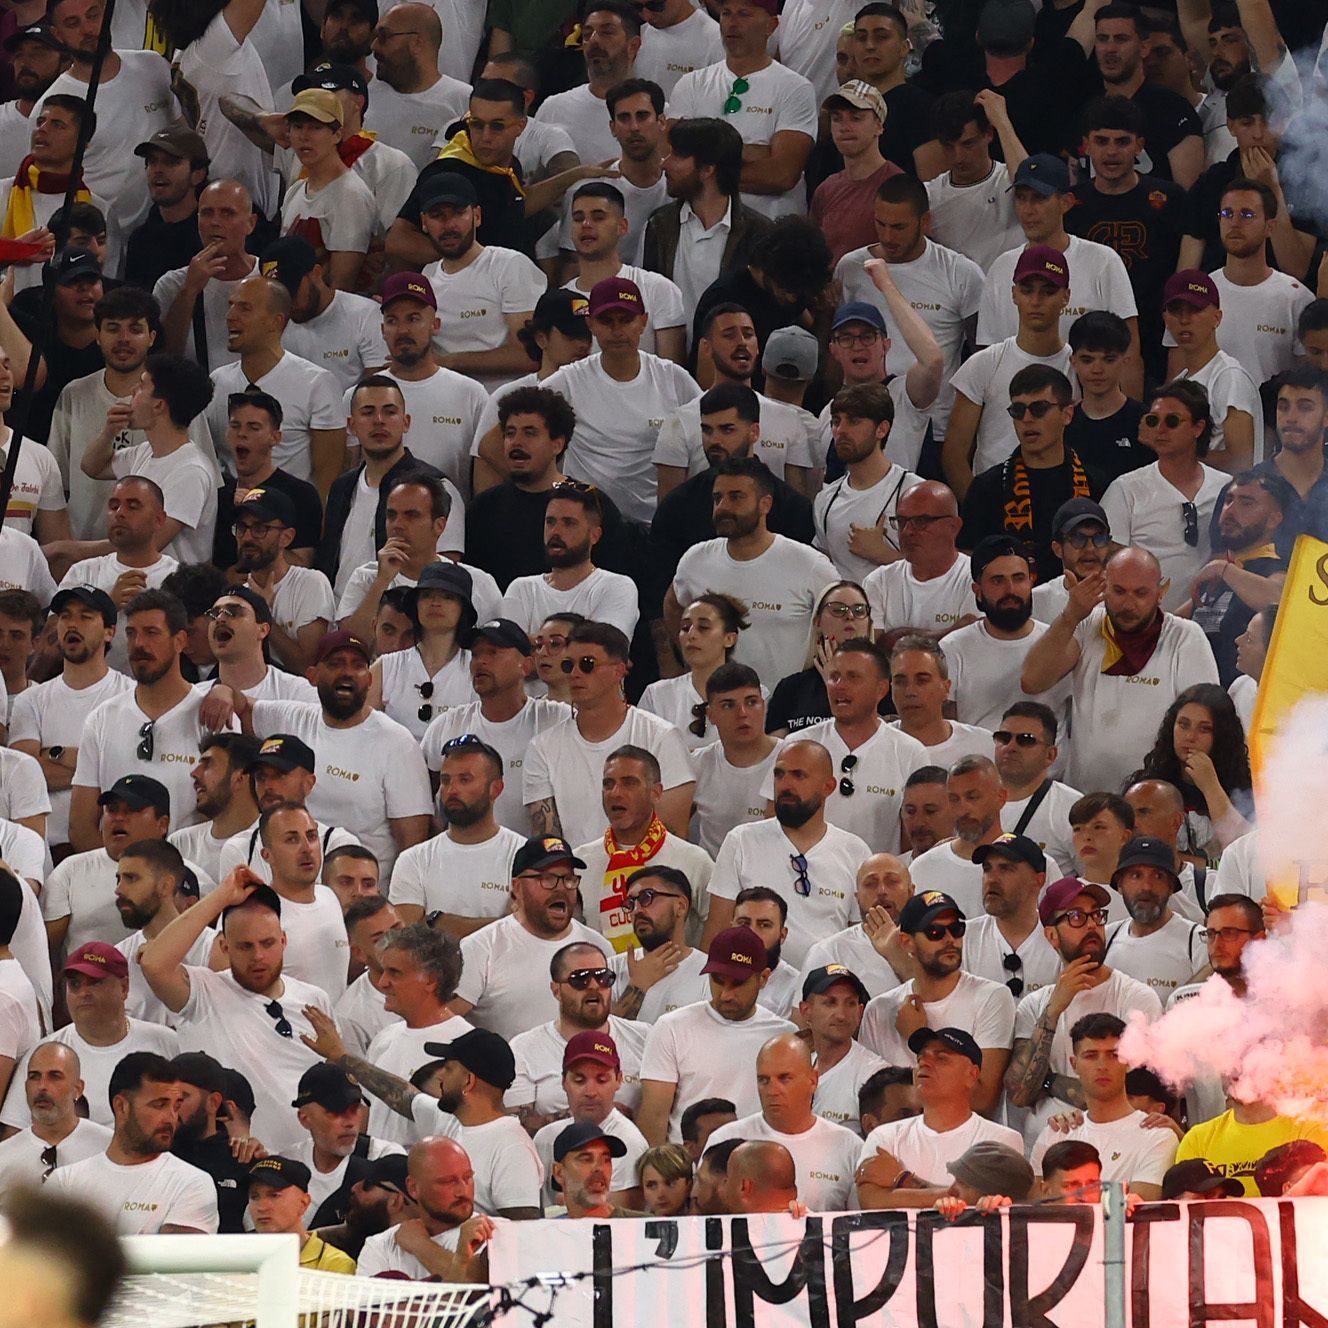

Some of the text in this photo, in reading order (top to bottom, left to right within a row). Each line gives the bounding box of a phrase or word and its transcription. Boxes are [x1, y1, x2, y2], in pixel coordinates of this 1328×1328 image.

[911, 302, 937, 312] ROMA
[460, 309, 481, 320] ROMA
[1256, 324, 1282, 335] ROMA
[433, 416, 457, 425] ROMA
[752, 602, 777, 611] ROMA
[788, 718, 806, 729] THE
[160, 753, 189, 764] ROMA
[327, 766, 352, 781] ROMA
[867, 786, 890, 797] ROMA
[84, 952, 107, 965] ROMA
[730, 952, 753, 965] ROMA
[1147, 978, 1171, 988] ROMA
[809, 1171, 834, 1181] ROMA
[124, 1201, 151, 1213] ROMA
